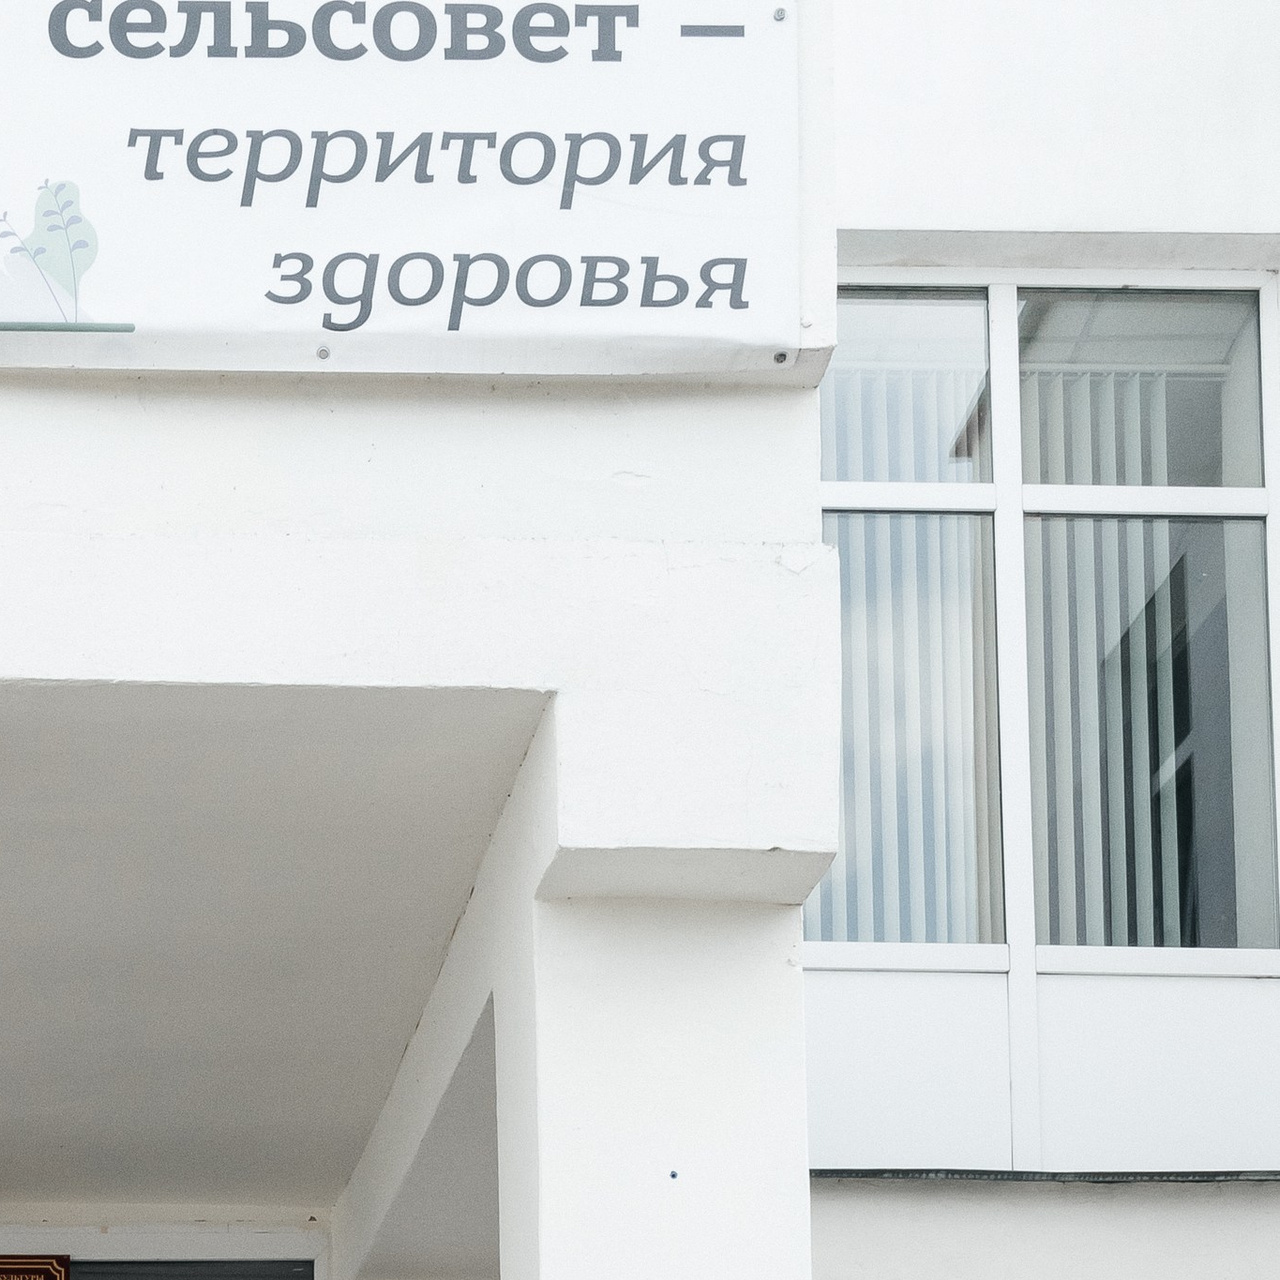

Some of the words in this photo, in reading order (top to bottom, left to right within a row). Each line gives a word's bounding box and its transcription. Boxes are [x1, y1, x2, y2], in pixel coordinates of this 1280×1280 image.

[47, 0, 640, 63] сельсовет
[127, 127, 749, 210] территория
[264, 249, 750, 332] здоровья
